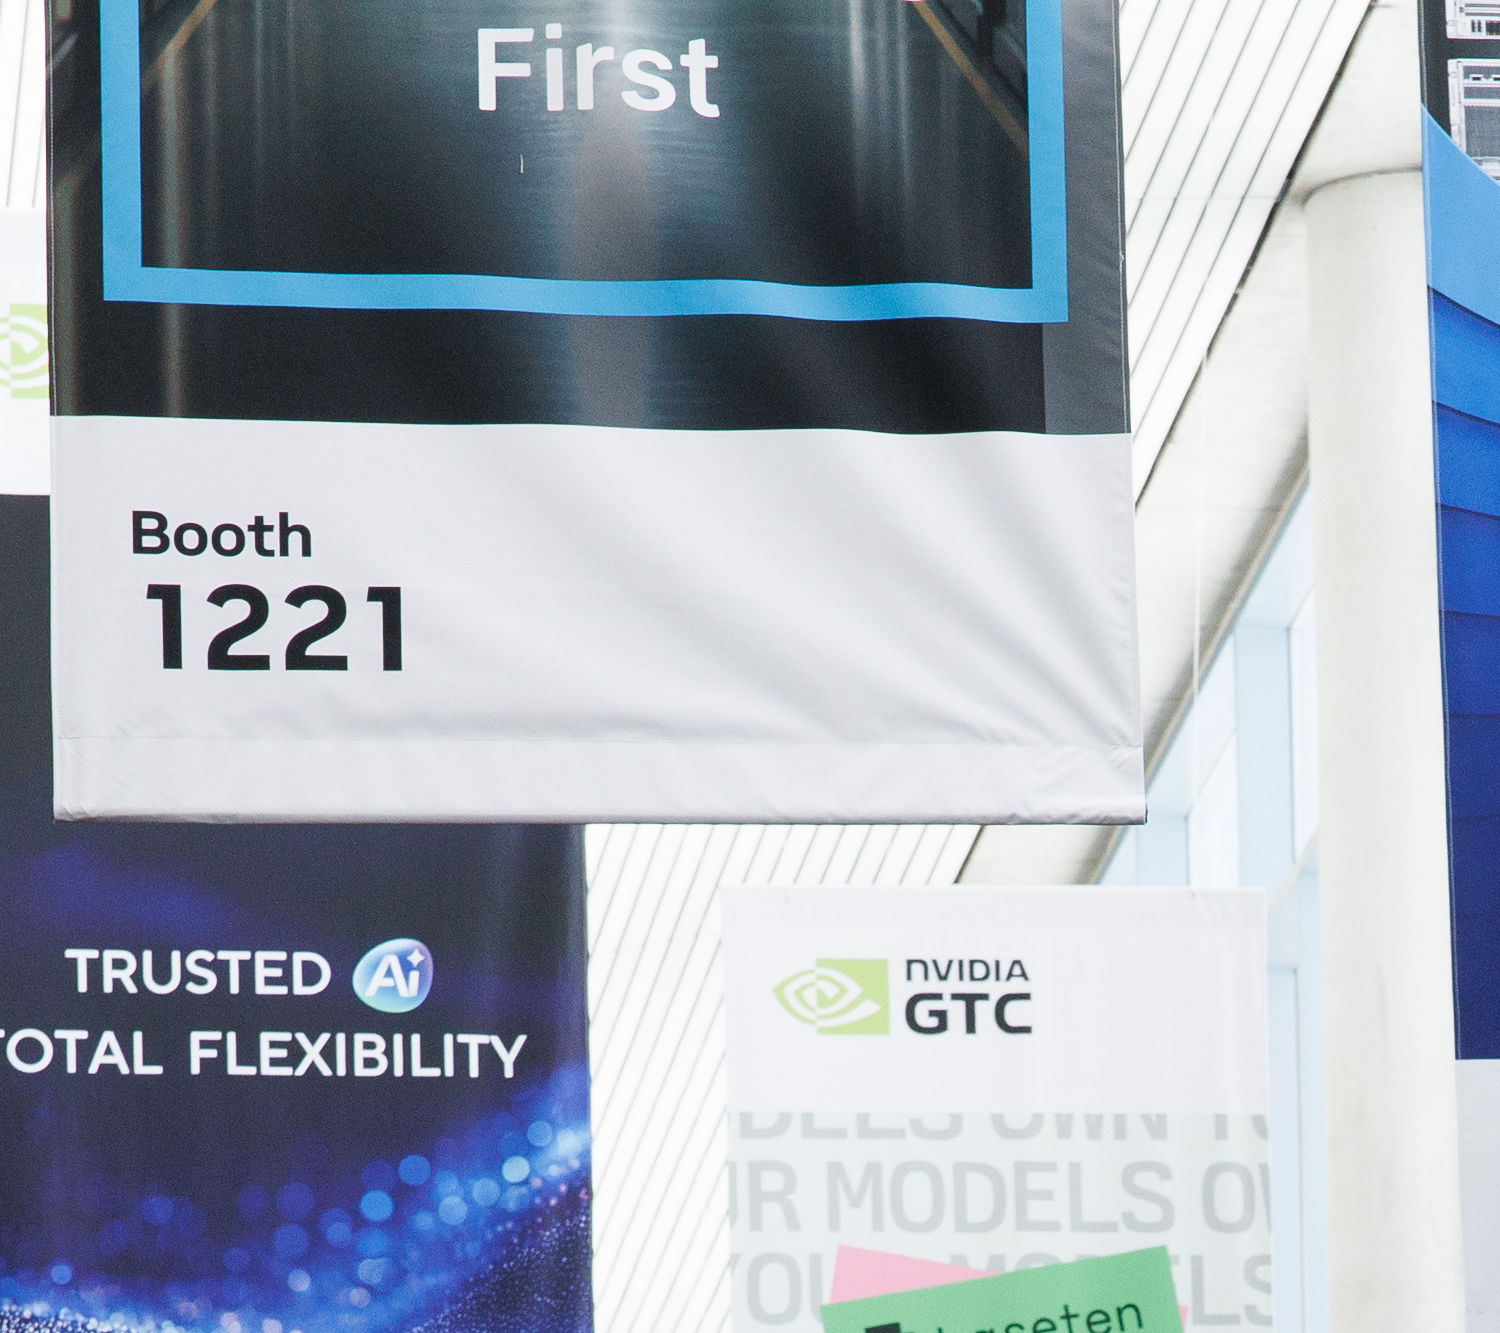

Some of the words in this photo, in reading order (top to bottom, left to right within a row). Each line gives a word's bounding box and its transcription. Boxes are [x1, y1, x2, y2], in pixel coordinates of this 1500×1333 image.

[477, 25, 721, 122] First
[131, 509, 314, 560] Booth
[146, 582, 407, 674] 1221
[65, 947, 331, 998] TRUSTED
[905, 958, 1030, 983] NVIDIA
[905, 991, 1033, 1035] GTC
[189, 1032, 527, 1080] FLEXIBILITY
[828, 1160, 1175, 1234] MODELS
